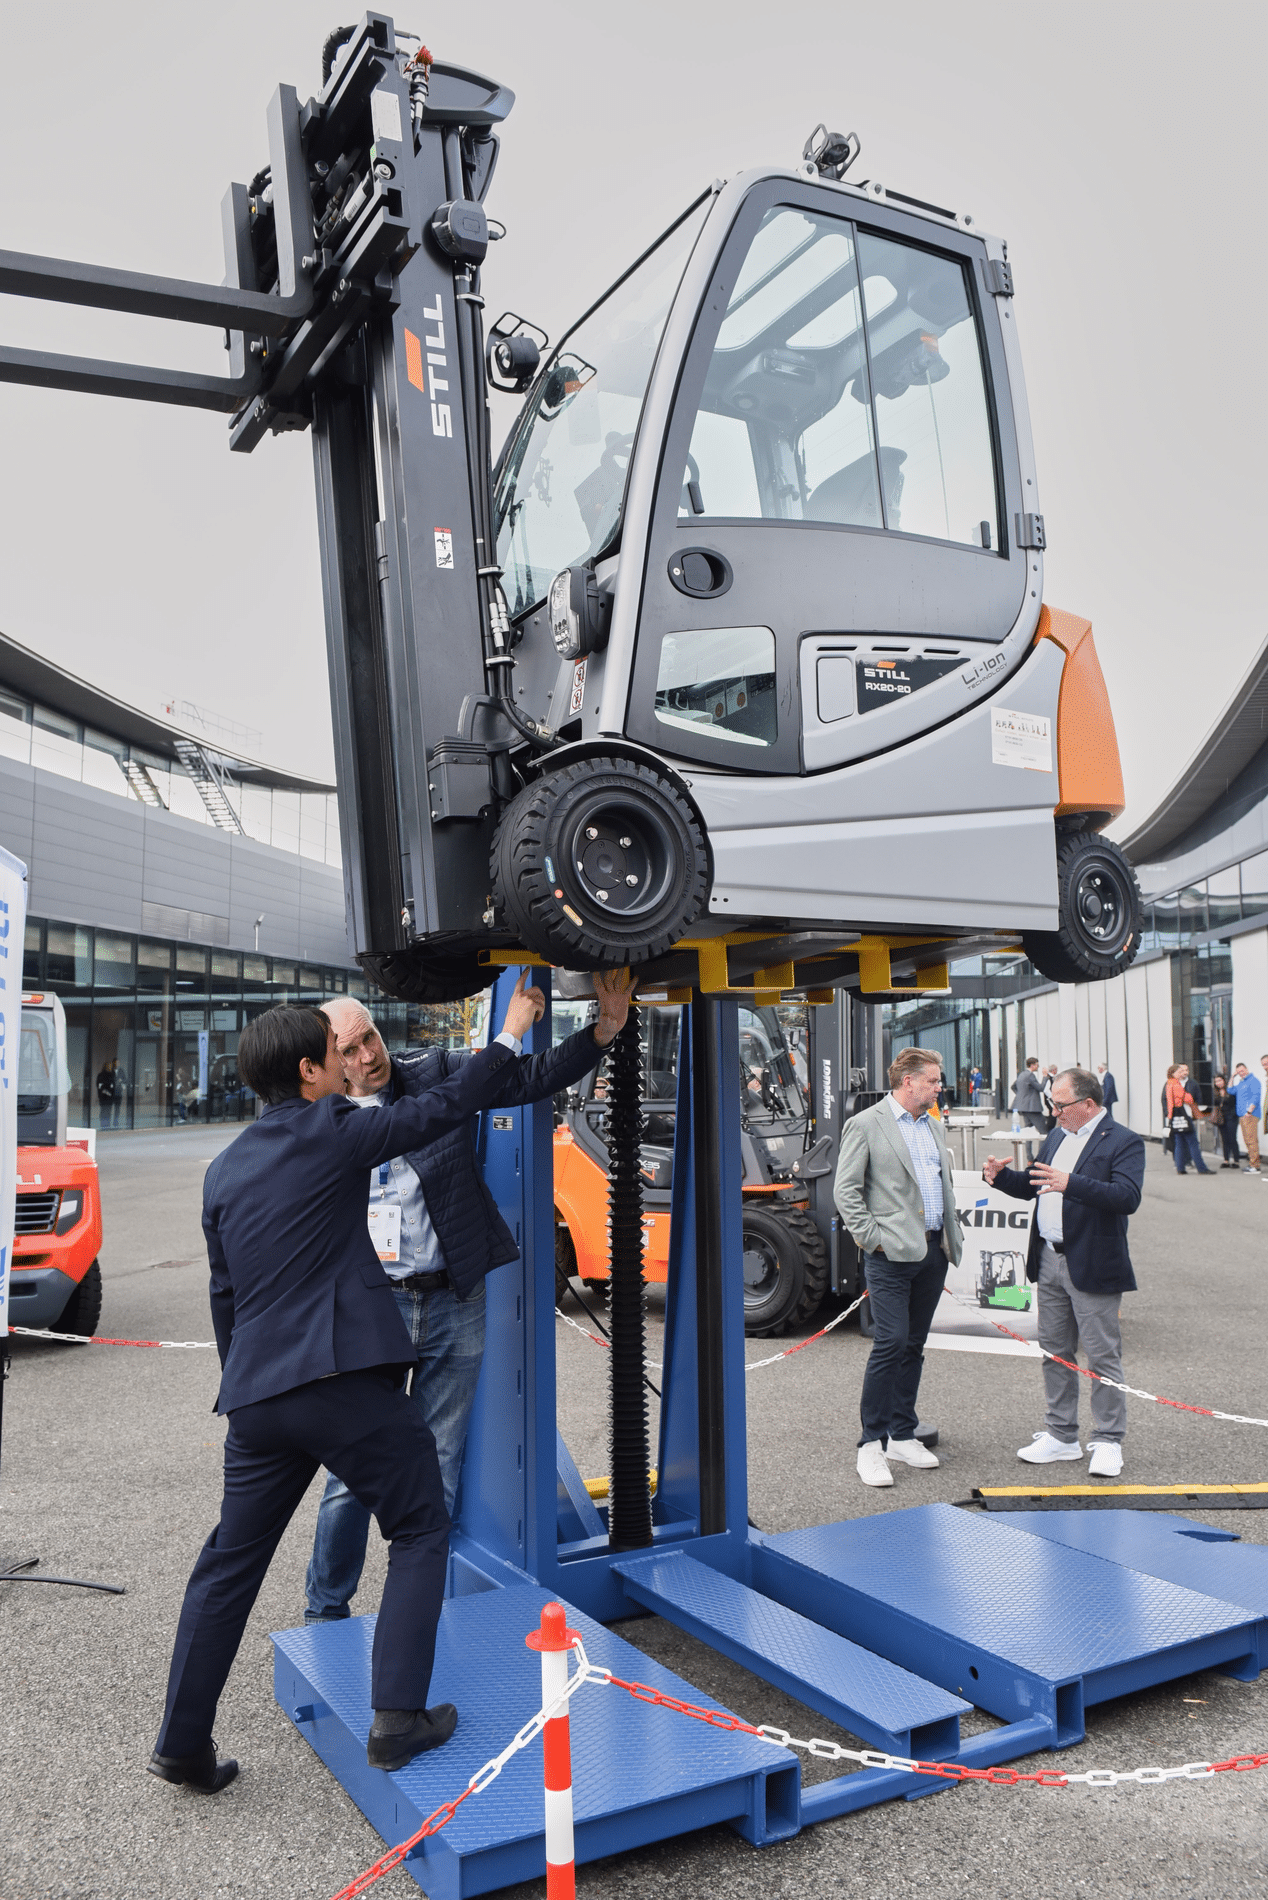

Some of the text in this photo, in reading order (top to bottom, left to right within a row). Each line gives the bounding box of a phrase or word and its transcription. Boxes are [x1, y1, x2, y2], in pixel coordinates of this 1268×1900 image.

[423, 293, 453, 438] STILL
[864, 667, 911, 681] STILL
[961, 652, 1006, 685] Li-Ion
[967, 662, 1008, 691] TECHNOLOGY
[865, 682, 912, 694] RX20-20
[387, 1238, 393, 1247] E
